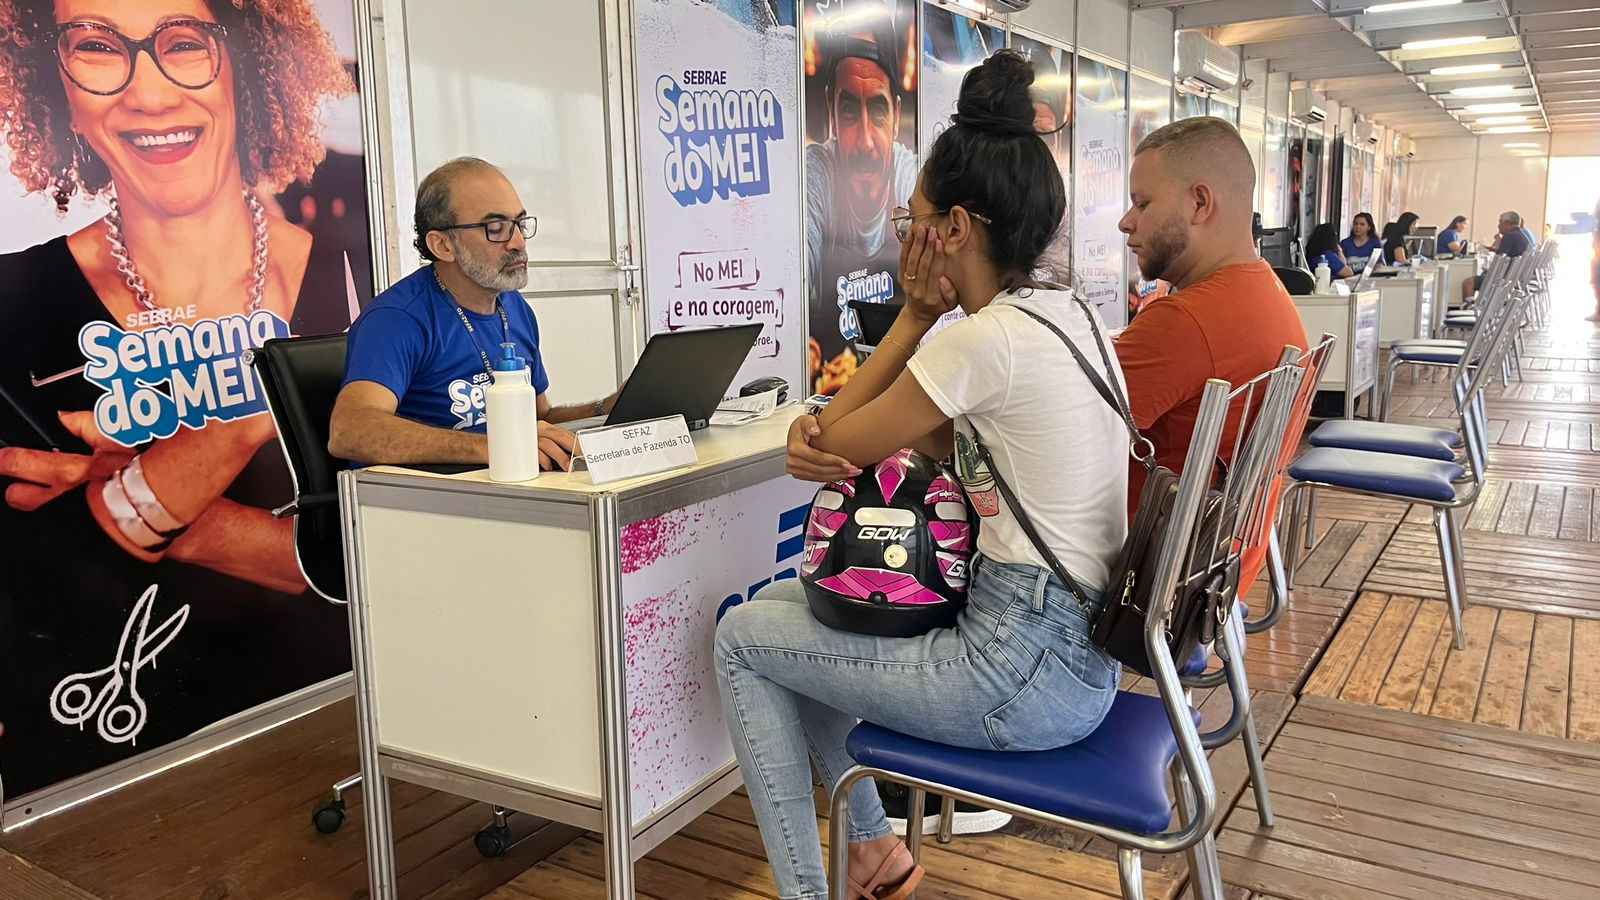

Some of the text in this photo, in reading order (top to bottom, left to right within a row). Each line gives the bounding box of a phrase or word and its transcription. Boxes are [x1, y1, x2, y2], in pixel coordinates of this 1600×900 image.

[683, 70, 727, 85] SEBRAE
[656, 74, 776, 134] Semana
[664, 132, 761, 194] do MEI
[693, 258, 743, 283] No MEI
[848, 268, 868, 281] SEBRAE
[837, 271, 889, 306] Semana
[125, 303, 197, 329] SEBRAE
[674, 298, 779, 320] e na coragem,
[839, 304, 856, 334] do
[80, 310, 278, 379] Semana
[96, 356, 256, 436] do MEI
[622, 425, 652, 441] SEFAZ
[586, 434, 691, 464] Secretaria de Fazenda TO
[857, 526, 912, 541] GOW
